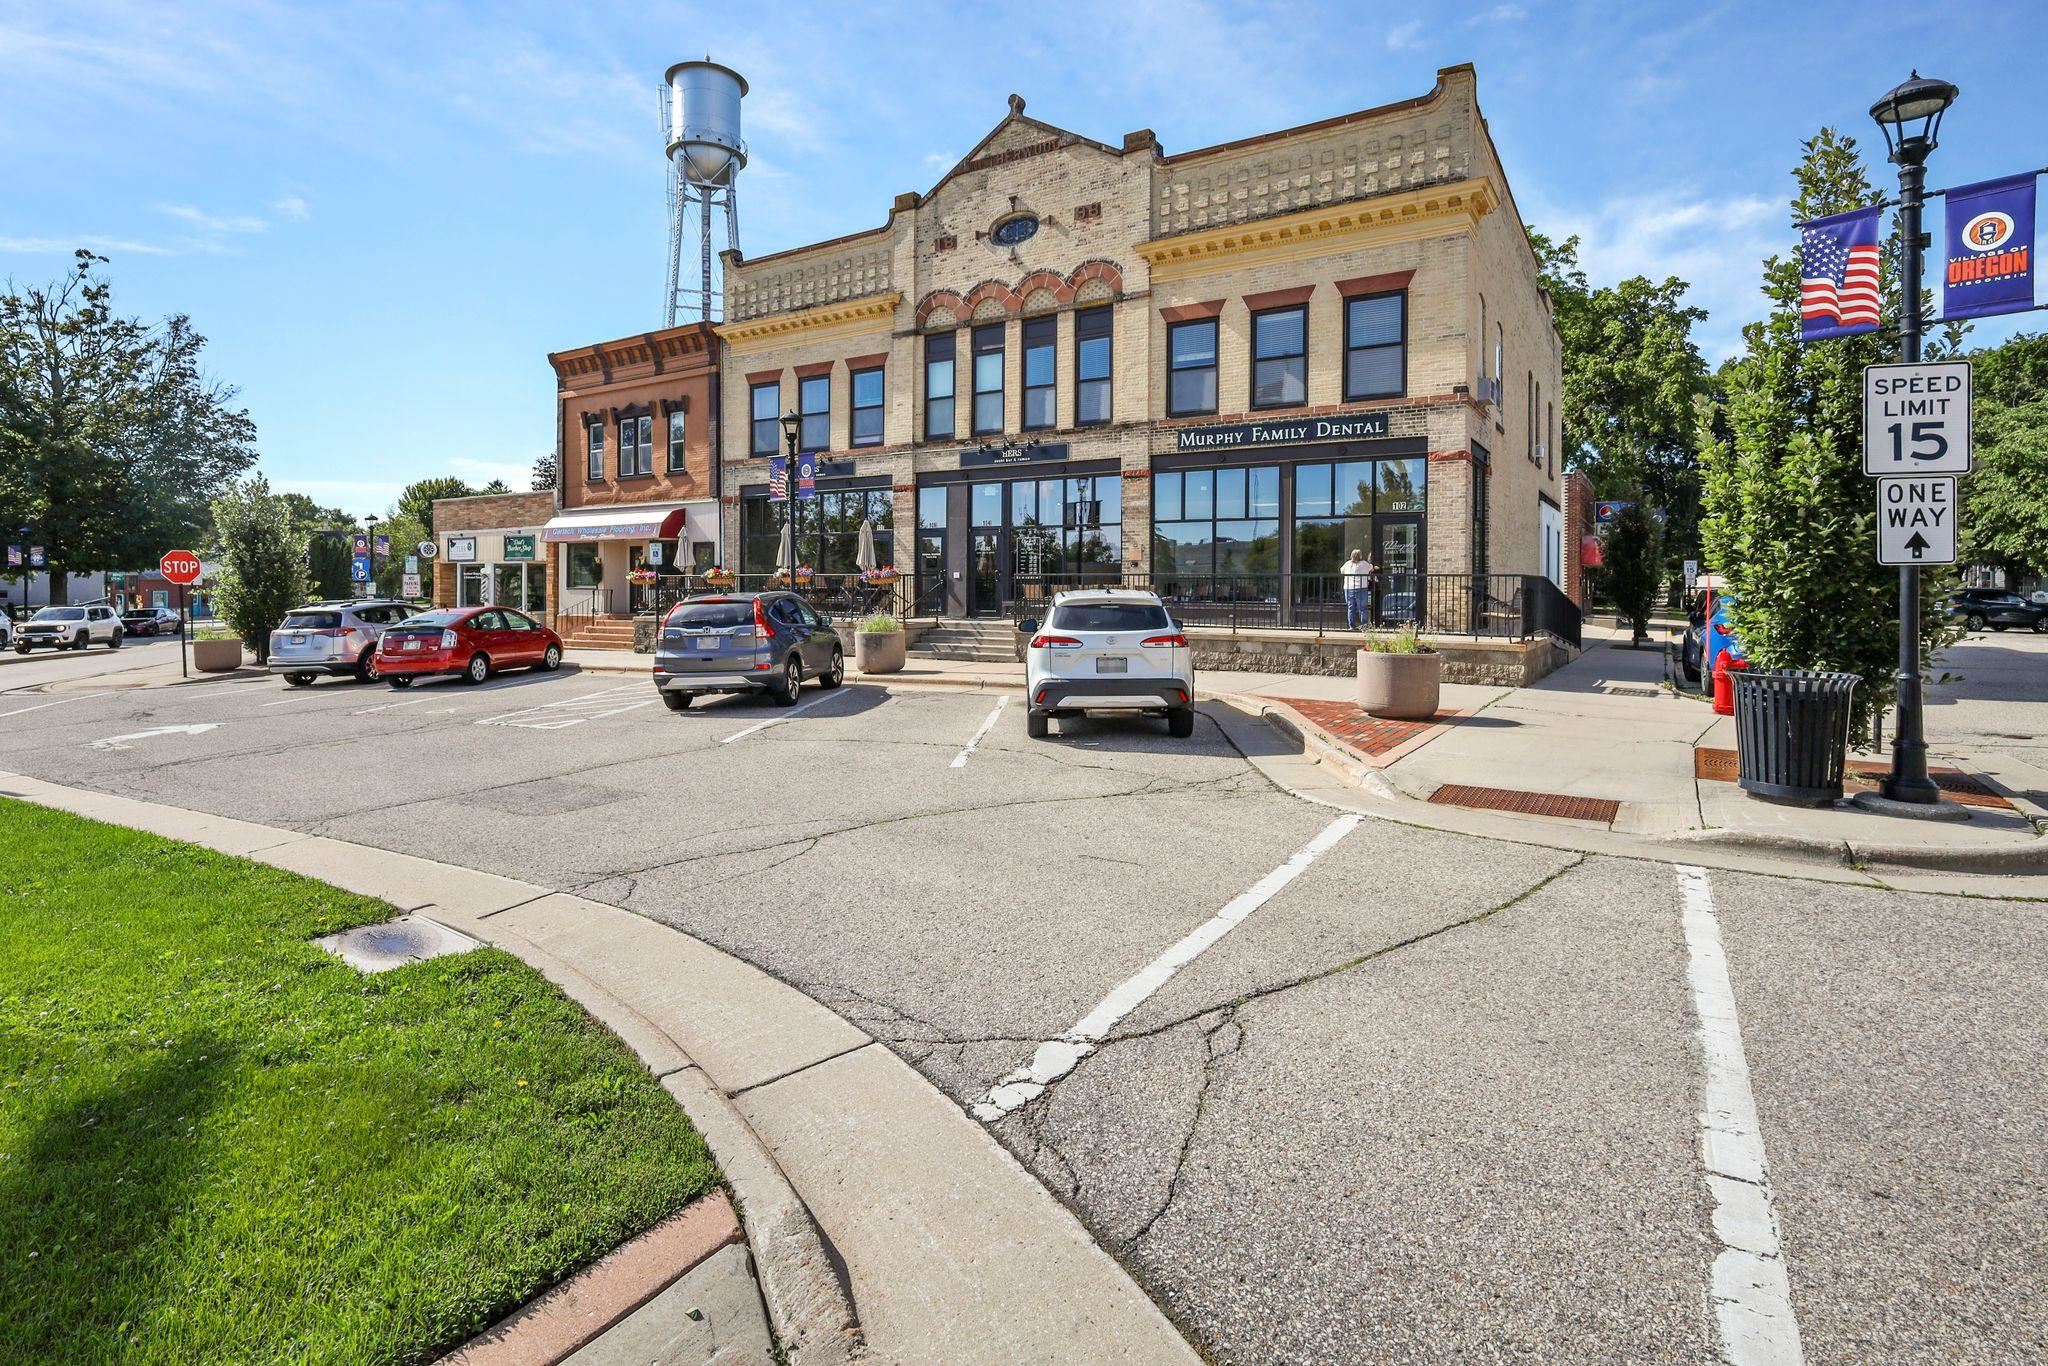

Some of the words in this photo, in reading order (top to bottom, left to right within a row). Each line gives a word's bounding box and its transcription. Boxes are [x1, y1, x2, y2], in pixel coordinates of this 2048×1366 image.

[1949, 249, 2004, 263] VILLAGE
[1948, 250, 2027, 283] OREGON
[1948, 272, 2027, 288] WISCONSIN
[1874, 376, 1961, 395] SPEED
[1884, 399, 1950, 416] LIMIT
[1180, 432, 1244, 447] MURPHY
[1252, 427, 1308, 442] FAMILY
[1317, 421, 1384, 437] DENTAL
[1887, 422, 1948, 462] 15
[1887, 483, 1946, 503] ONE
[1393, 502, 1406, 510] 102
[1888, 507, 1947, 527] WAY
[163, 560, 198, 574] STOP
